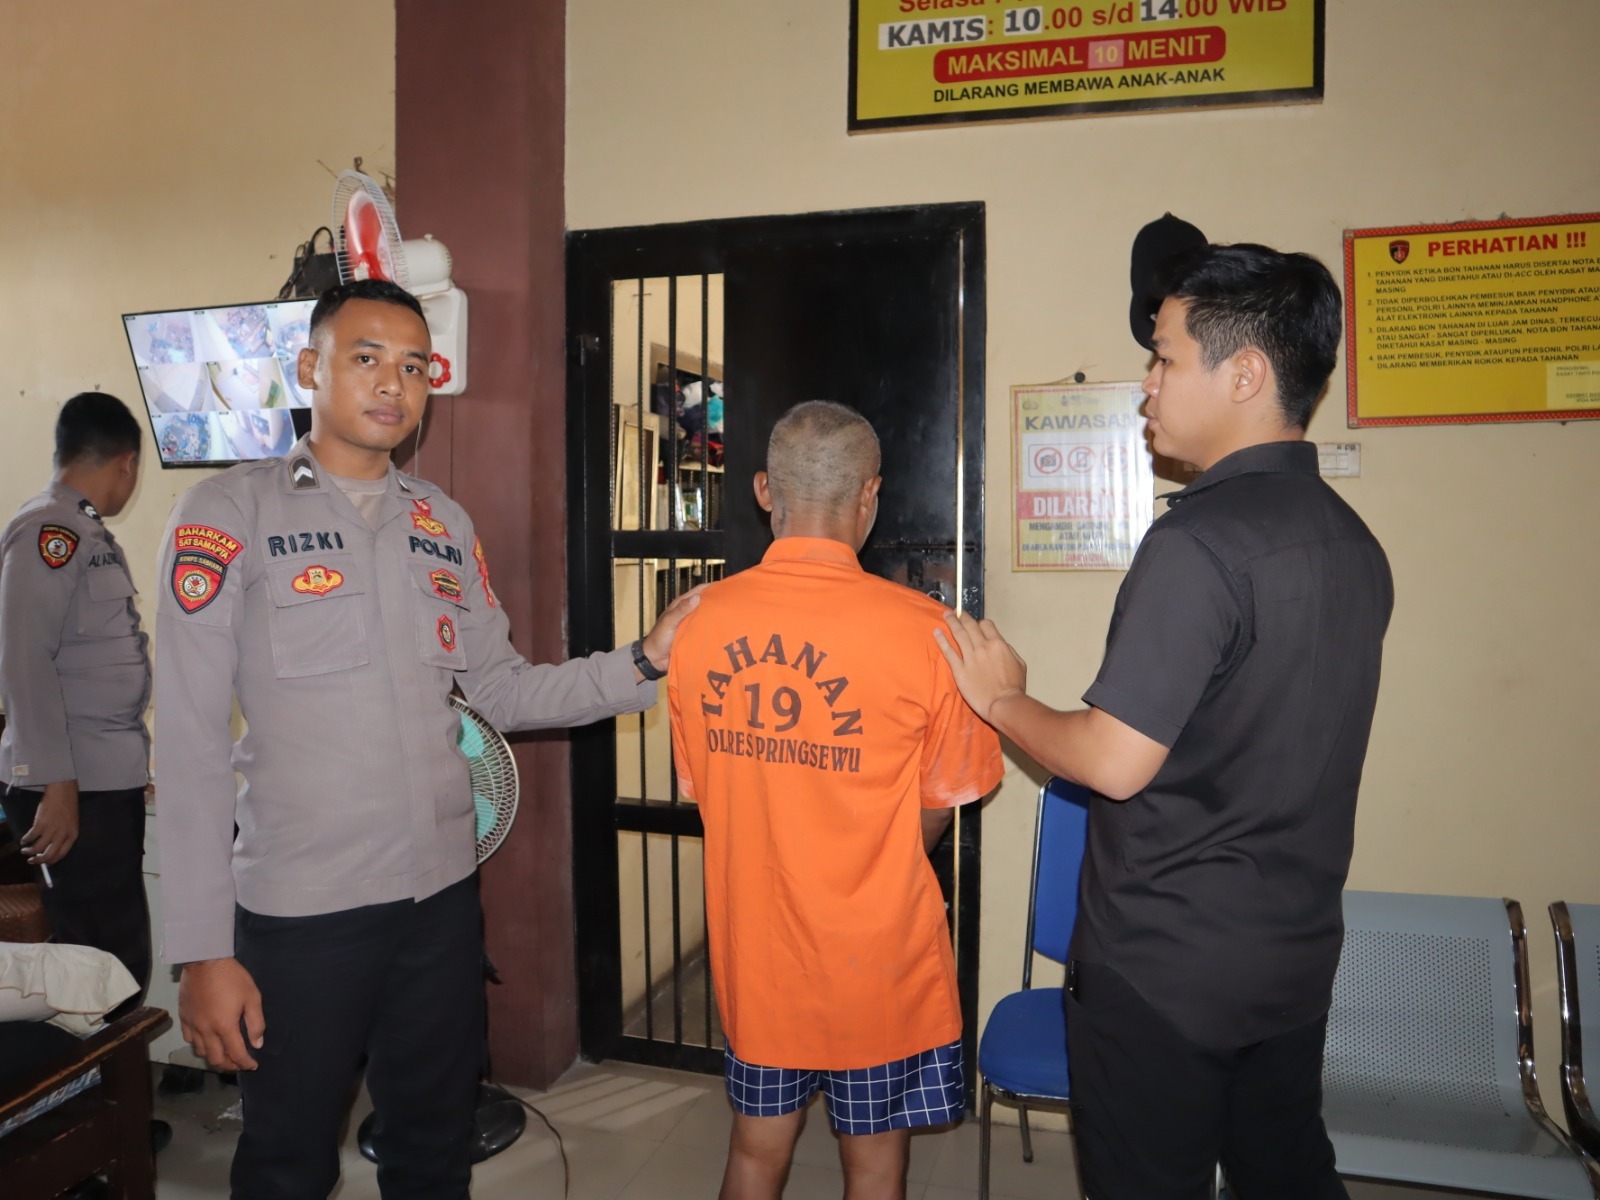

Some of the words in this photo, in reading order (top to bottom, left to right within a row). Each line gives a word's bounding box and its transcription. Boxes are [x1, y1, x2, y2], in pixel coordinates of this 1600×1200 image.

[1005, 7, 1082, 32] 10.00
[1092, 3, 1133, 25] s/d
[1141, 0, 1218, 21] 14.00
[949, 46, 1083, 75] MAKSIMAL
[1095, 45, 1118, 63] 10
[1128, 35, 1211, 60] MENIT
[934, 84, 1018, 102] DILARANG
[1024, 76, 1114, 95] MEMBAWA
[1118, 68, 1225, 88] ANAK-ANAK
[1428, 233, 1558, 257] PERHATIAN
[1375, 269, 1411, 277] PENYIDIK
[1413, 267, 1441, 275] KETIKA
[1463, 264, 1500, 272] TAHANAN
[1503, 261, 1531, 269] HARUS
[1533, 259, 1570, 268] DISERTAI
[1376, 277, 1413, 285] TAHANAN
[1438, 273, 1480, 282] DIKETAHUI
[1534, 268, 1556, 276] OLEH
[1559, 266, 1585, 275] KASAT
[1376, 286, 1406, 294] MASING
[1376, 297, 1399, 305] TIDAK
[1401, 293, 1468, 304] DIPERBOLEHKAN
[1470, 292, 1514, 300] PEMBESUK
[1538, 287, 1576, 296] PENYIDIK
[1376, 305, 1414, 313] PERSONIL
[1442, 302, 1476, 310] LAINNYA
[1478, 299, 1538, 308] MEMINJAMKAN
[1540, 295, 1592, 304] HANDPHONE
[1376, 314, 1396, 322] ALAT
[1398, 312, 1447, 320] ELEKTRONIK
[1449, 310, 1483, 318] LAINNYA
[1485, 308, 1518, 316] KEPADA
[1520, 306, 1559, 314] TAHANAN
[1376, 325, 1417, 333] DILARANG
[1438, 321, 1476, 330] TAHANAN
[1488, 320, 1509, 328] LUAR
[1398, 332, 1430, 341] SANGAT
[1436, 330, 1468, 338] SANGAT
[1526, 326, 1549, 334] NOTA
[1550, 325, 1568, 333] BON
[1376, 341, 1418, 350] DIKETAHUI
[1419, 340, 1445, 348] KASAT
[1485, 337, 1517, 345] MASING
[1445, 349, 1482, 357] PENYIDIK
[1483, 348, 1521, 356] ATAUPUN
[1522, 345, 1562, 354] PERSONIL
[1377, 361, 1417, 369] DILARANG
[1419, 359, 1472, 367] MEMBERIKAN
[1474, 357, 1504, 365] ROKOK
[1025, 413, 1138, 430] KAWASAN
[178, 527, 237, 551] BAHARKAM
[268, 531, 344, 557] RIZKI
[178, 538, 193, 548] SAT
[193, 538, 229, 560] SAMAPTA
[409, 535, 462, 566] POLRI
[700, 633, 863, 737] TAHANAN
[744, 683, 802, 733] 19
[707, 728, 753, 758] OLRES
[755, 735, 861, 773] PRINGSEWU
